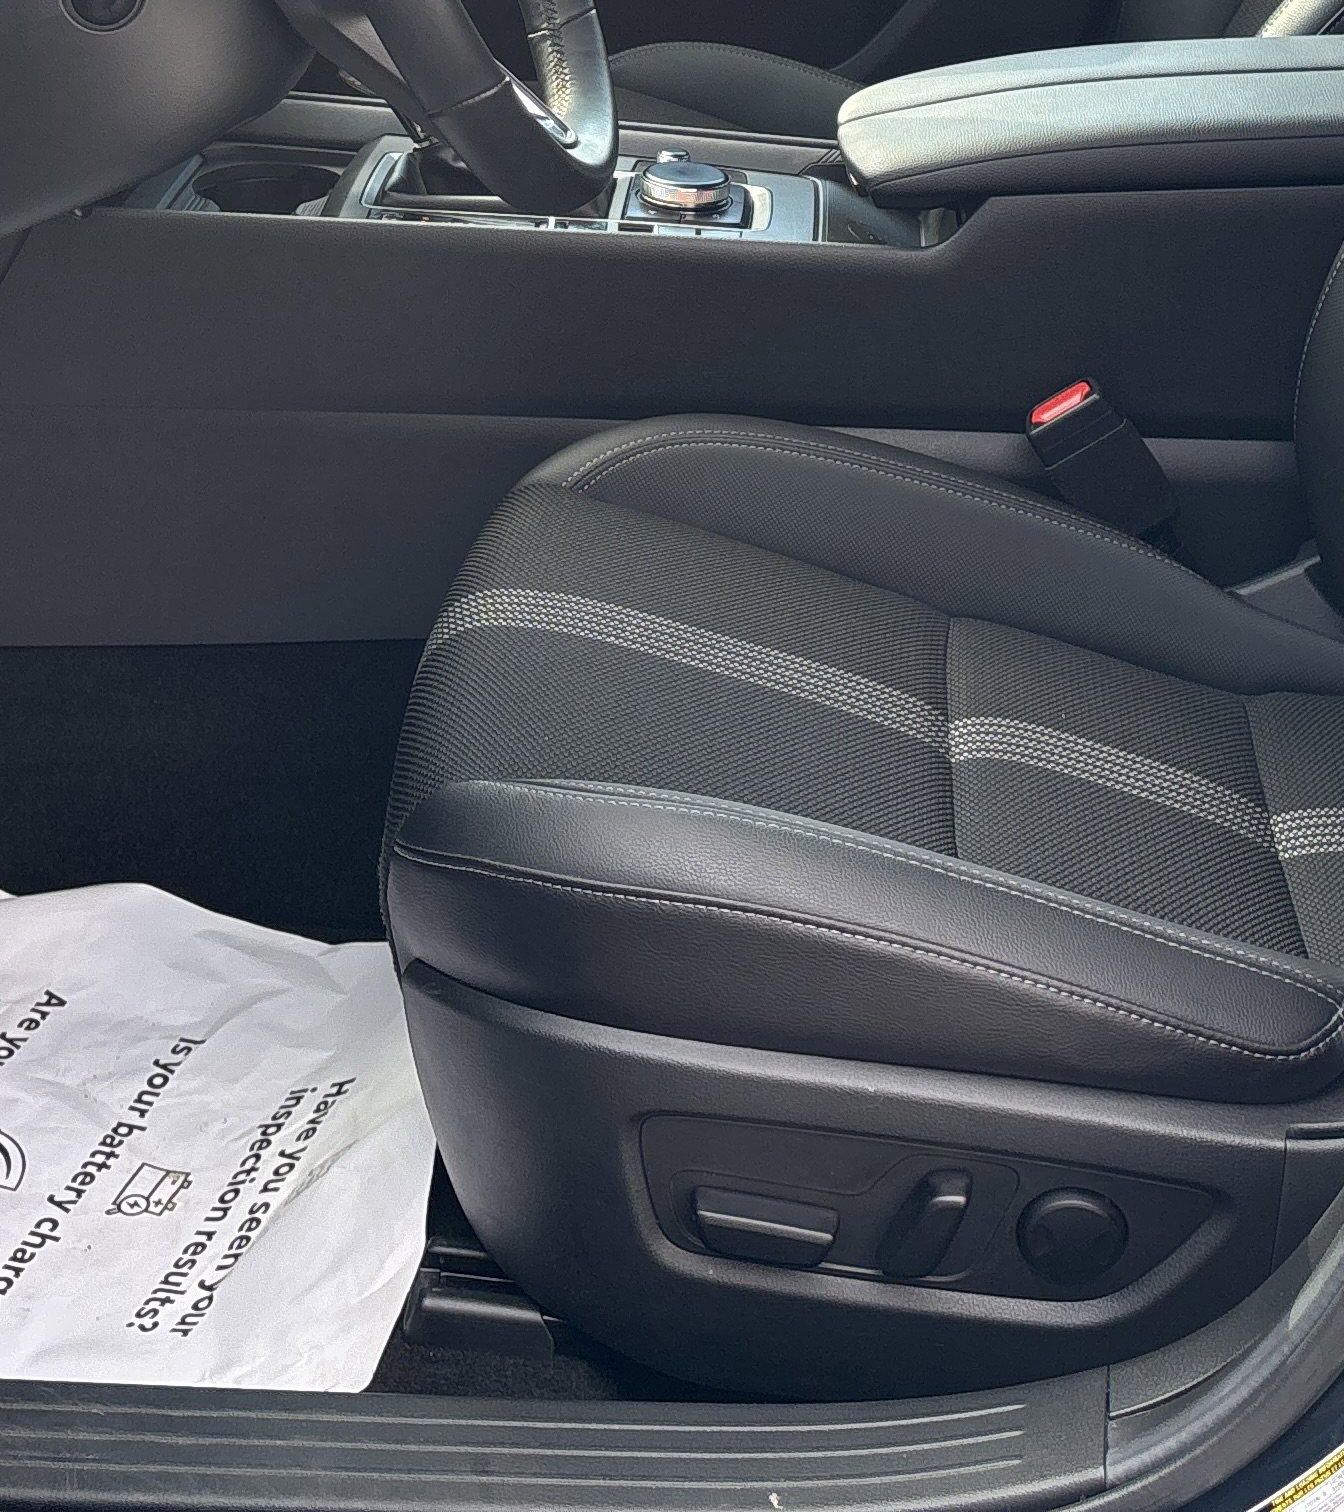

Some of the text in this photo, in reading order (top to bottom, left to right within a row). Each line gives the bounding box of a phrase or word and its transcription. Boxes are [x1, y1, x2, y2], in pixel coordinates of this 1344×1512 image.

[17, 988, 68, 1032] Are
[171, 1037, 206, 1057] Is
[128, 1058, 182, 1118] your
[47, 1121, 147, 1214] battery
[125, 1087, 318, 1333] inspection results?
[169, 1077, 356, 1337] Have you seen your
